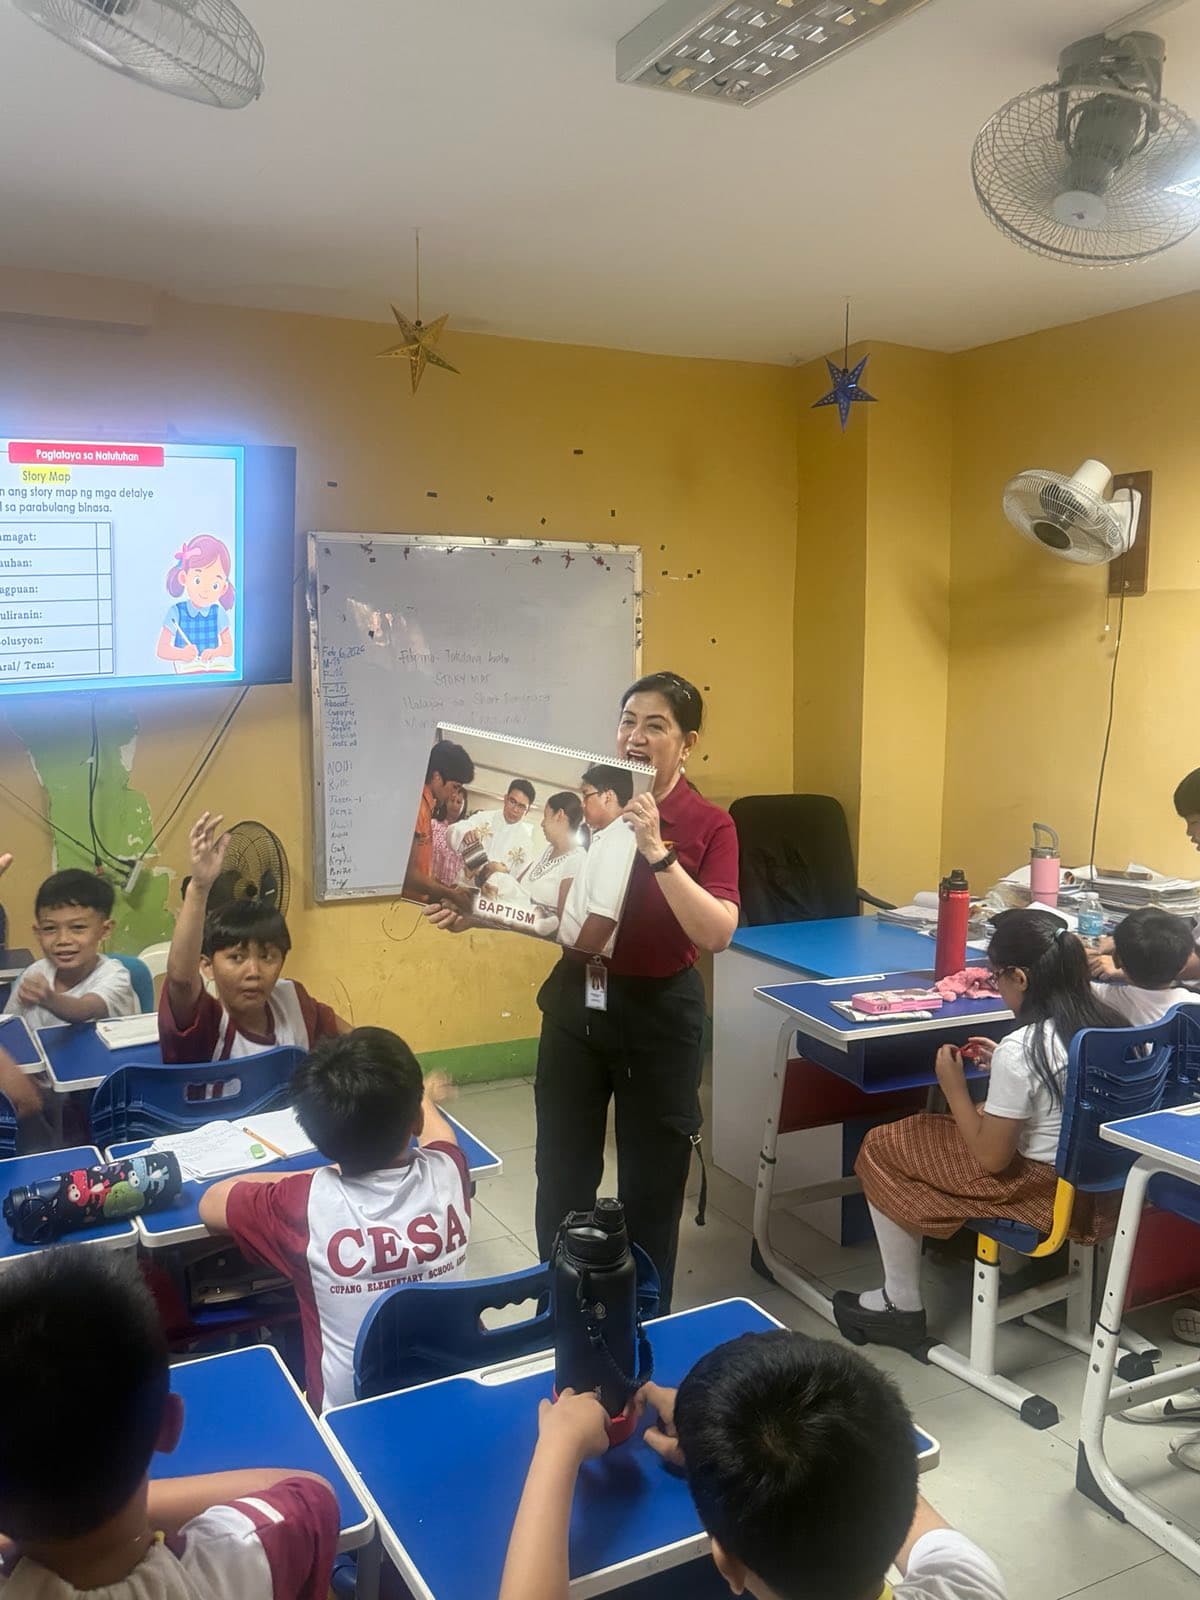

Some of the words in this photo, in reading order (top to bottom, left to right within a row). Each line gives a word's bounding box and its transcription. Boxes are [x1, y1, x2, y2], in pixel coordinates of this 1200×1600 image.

[36, 449, 81, 461] Pagtataya
[83, 451, 93, 460] sa
[95, 451, 139, 462] Natutuhan
[22, 470, 47, 483] Story
[49, 471, 71, 483] Map
[8, 488, 28, 498] ang
[30, 486, 53, 499] story
[55, 488, 78, 499] map
[80, 489, 93, 500] ng
[95, 489, 117, 500] mga
[119, 487, 154, 500] detalye
[5, 503, 16, 512] sa
[19, 502, 76, 514] parabulang
[78, 502, 112, 513] binasa.
[24, 660, 55, 670] Tema:
[477, 900, 536, 925] BAPTISM
[327, 1204, 467, 1277] CESA
[330, 1284, 362, 1294] CUPANG
[367, 1273, 423, 1292] ELEMENTARY
[428, 1263, 454, 1279] SCHOOL
